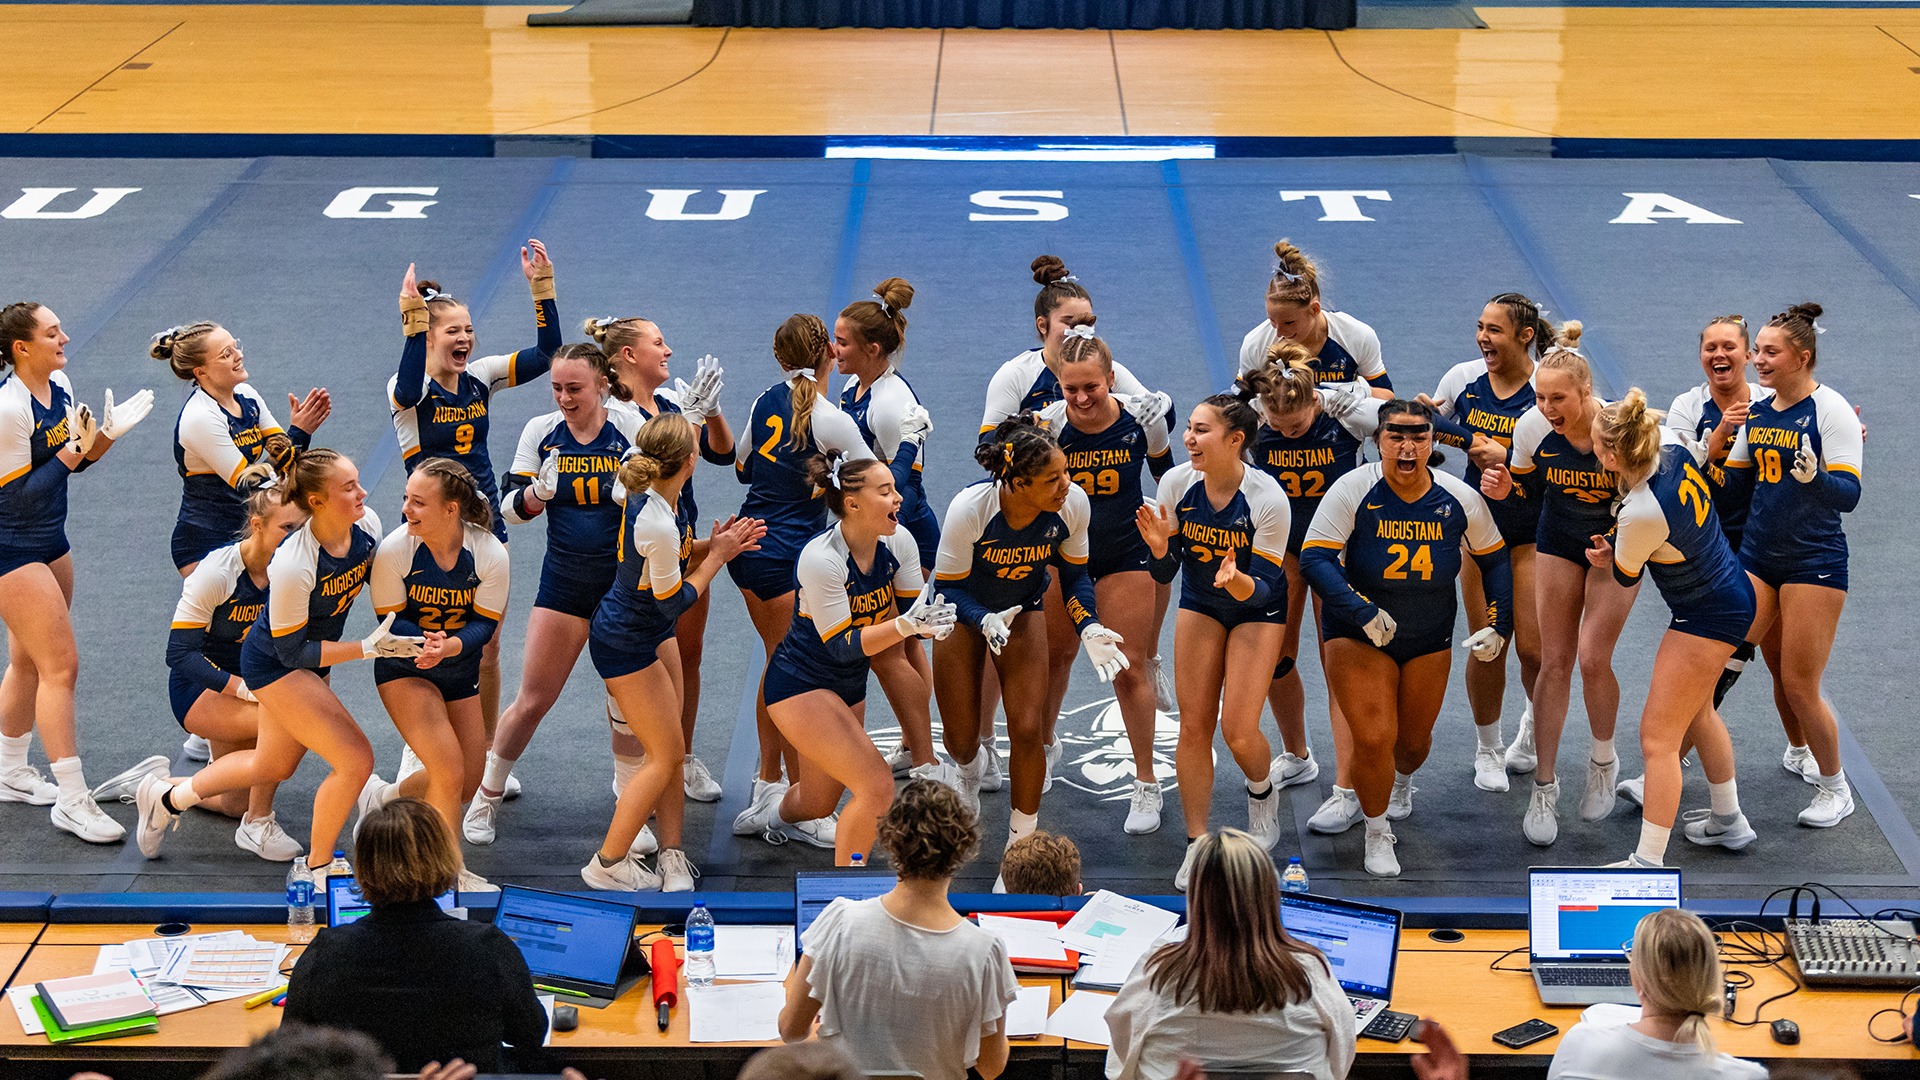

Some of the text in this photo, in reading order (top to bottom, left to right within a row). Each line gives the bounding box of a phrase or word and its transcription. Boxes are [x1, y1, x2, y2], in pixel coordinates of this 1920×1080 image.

[454, 423, 475, 455] 9
[758, 414, 784, 463] 2
[1267, 447, 1335, 468] AUGUSTANA
[1755, 448, 1782, 484] 18
[572, 476, 600, 505] 11
[1279, 470, 1326, 498] 32
[1678, 462, 1711, 528] 21
[1182, 520, 1250, 549] AUGUSTANA
[1376, 519, 1443, 541] AUGUSTANA
[982, 543, 1052, 565] AUGUSTANA
[1383, 543, 1434, 580] 24
[418, 606, 467, 630] 22
